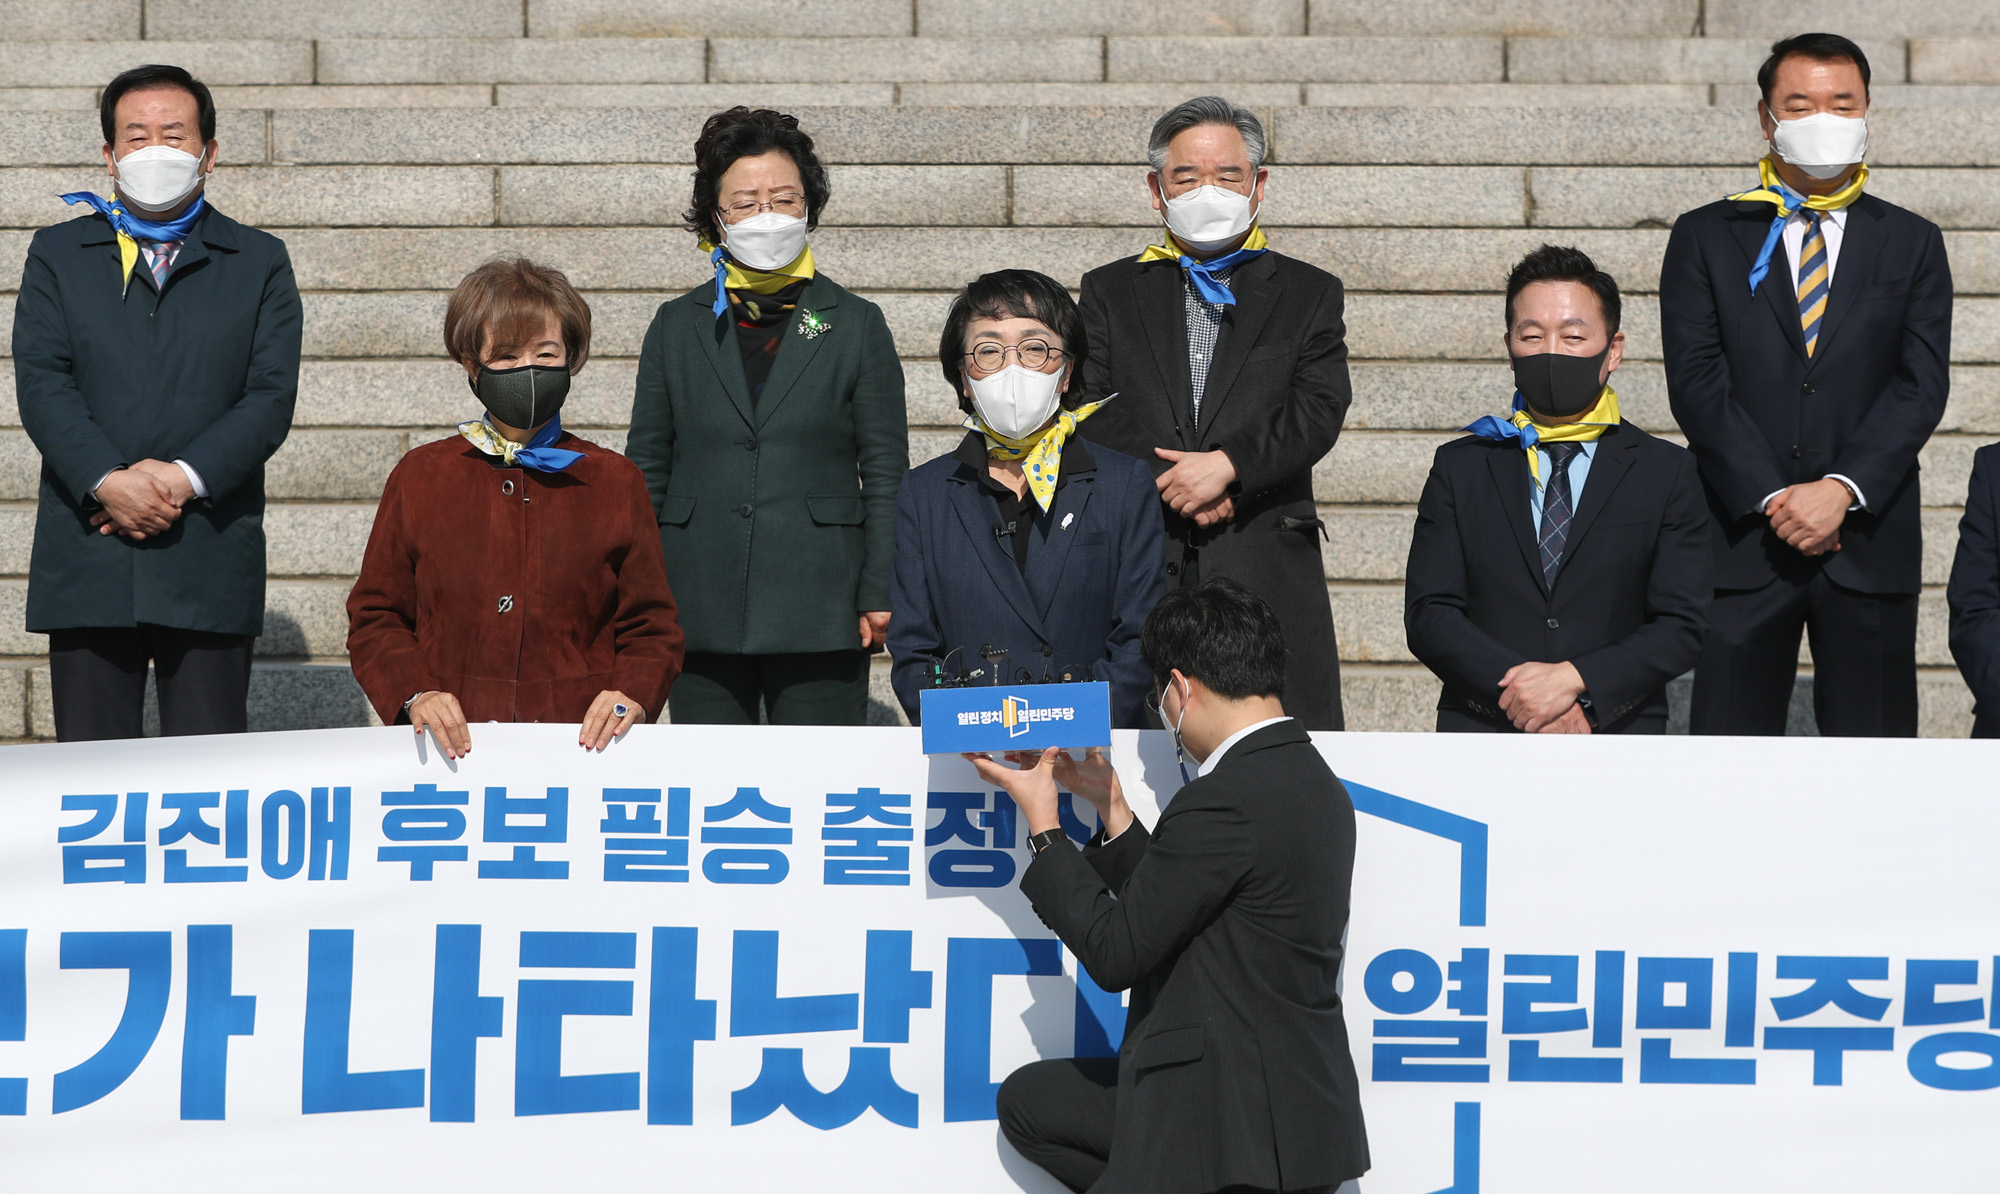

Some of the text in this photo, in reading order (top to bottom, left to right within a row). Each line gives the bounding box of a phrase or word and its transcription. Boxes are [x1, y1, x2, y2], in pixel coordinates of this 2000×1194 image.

[957, 706, 1075, 726] 열린 정치 열린민주당
[57, 786, 352, 885] 김진애
[377, 783, 570, 882] 후보
[600, 786, 793, 885] 필승
[0, 924, 257, 1121] 가
[1363, 947, 2000, 1092] 열린민주당
